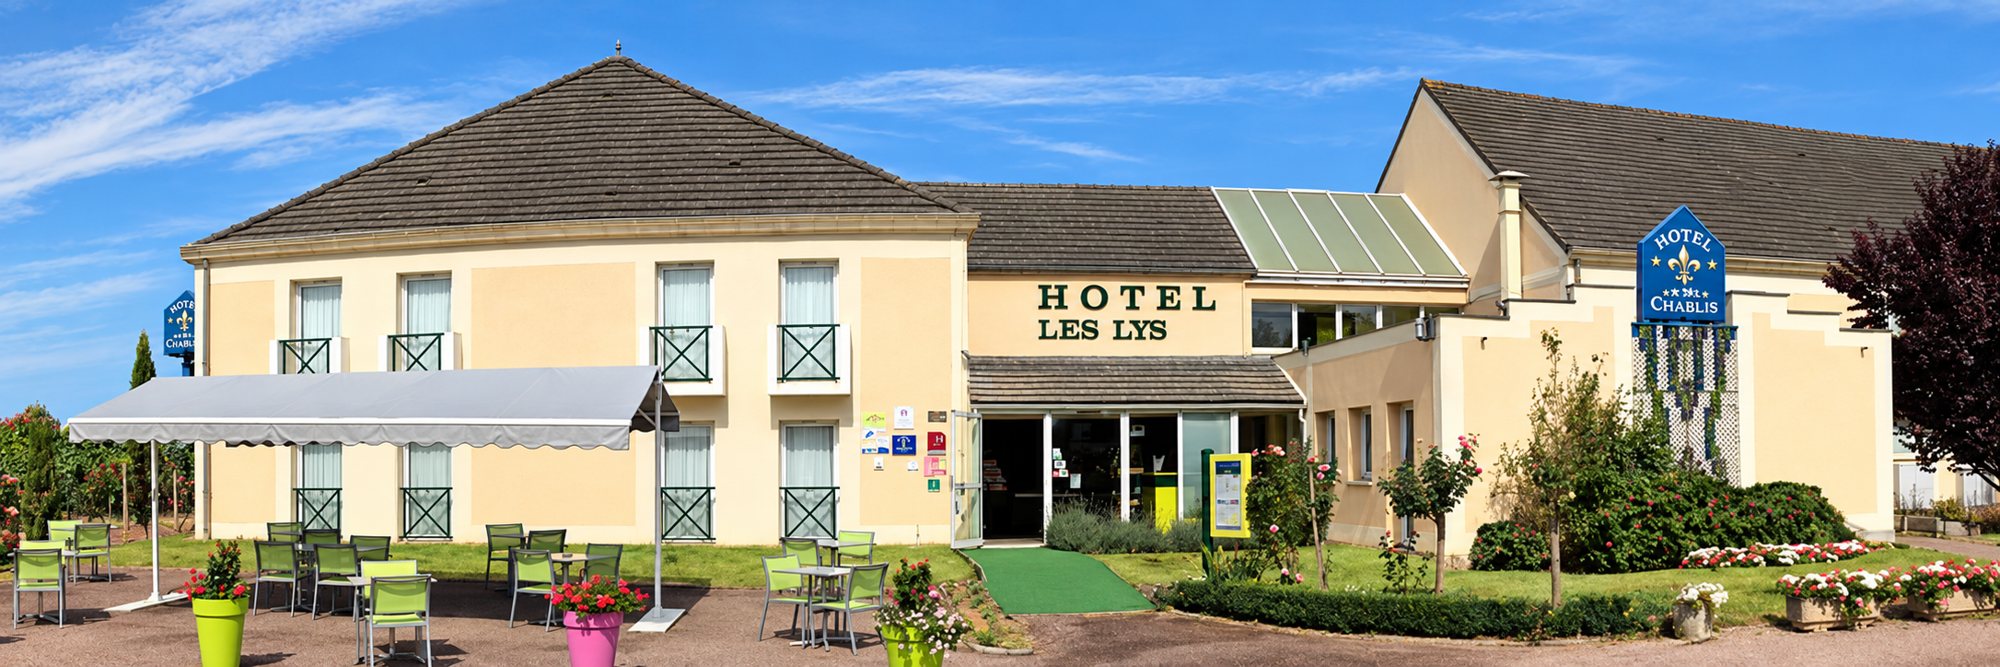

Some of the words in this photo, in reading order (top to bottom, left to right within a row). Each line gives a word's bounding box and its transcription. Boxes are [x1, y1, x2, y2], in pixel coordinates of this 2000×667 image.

[1654, 228, 1712, 253] HOTEL
[169, 300, 195, 314] HOTE
[1037, 284, 1217, 311] HOTEL
[1650, 295, 1718, 314] CHABLIS
[1037, 319, 1100, 341] LES
[1112, 319, 1168, 341] LYS
[165, 338, 195, 348] CHABL
